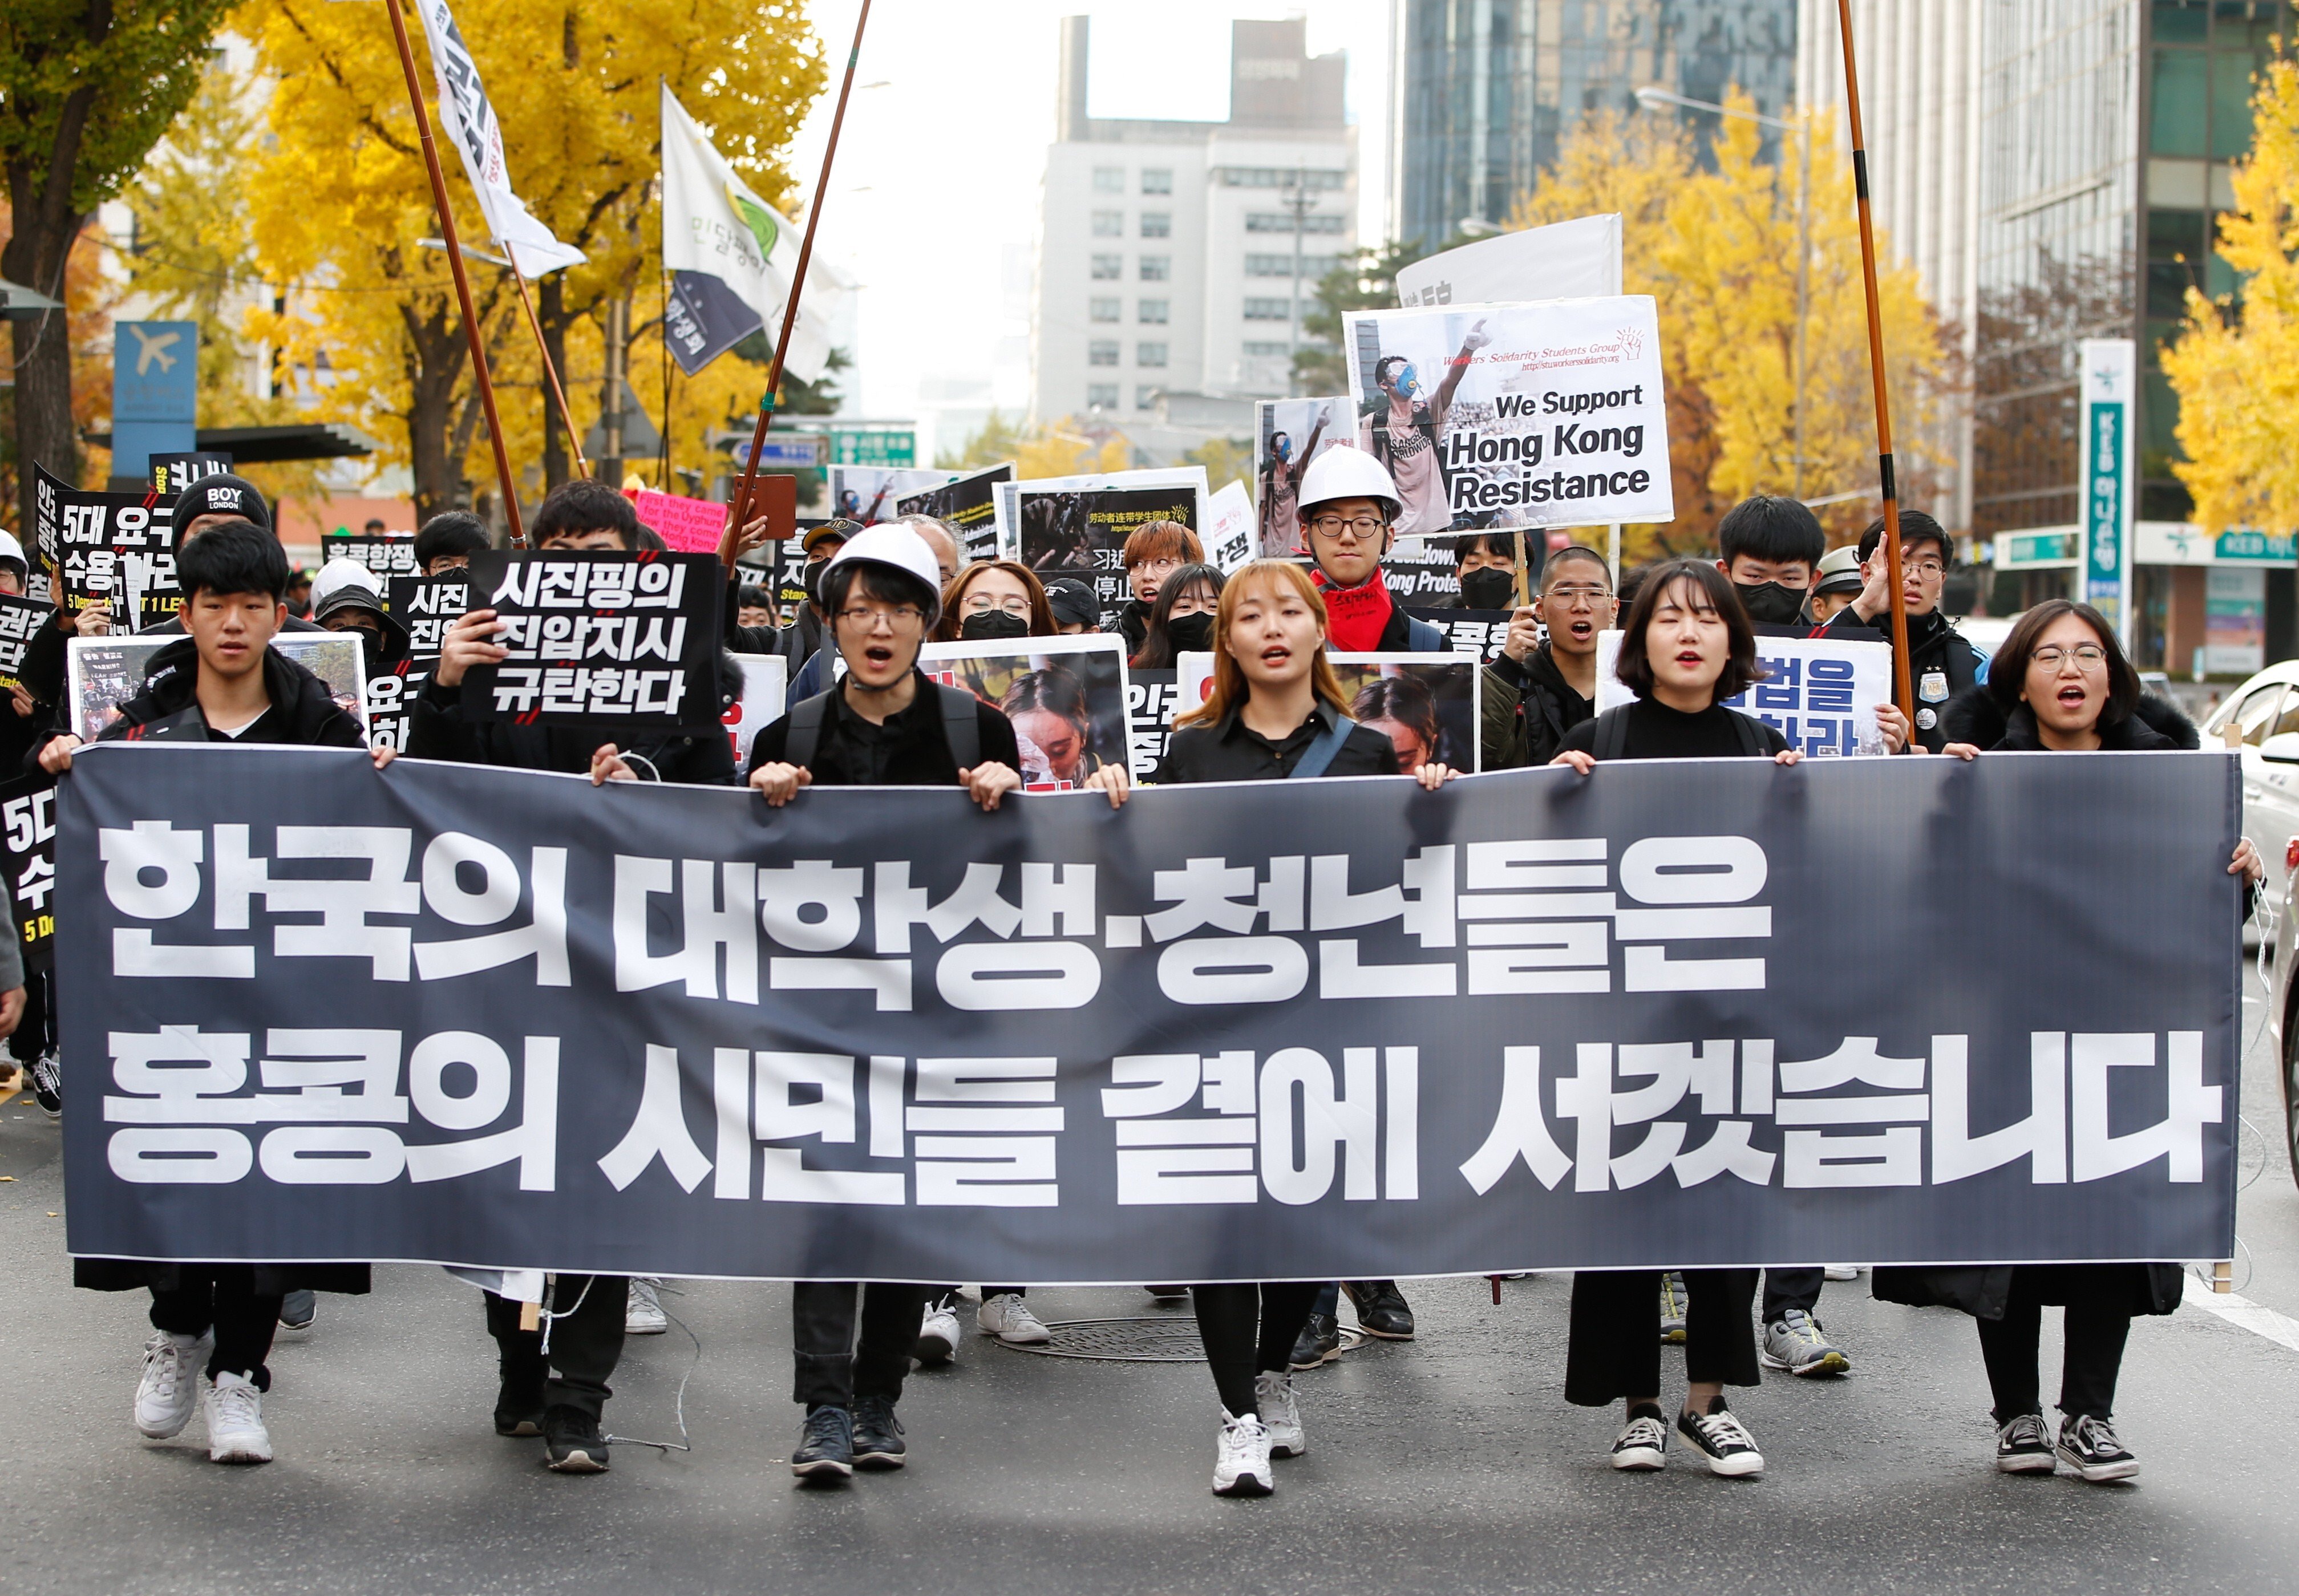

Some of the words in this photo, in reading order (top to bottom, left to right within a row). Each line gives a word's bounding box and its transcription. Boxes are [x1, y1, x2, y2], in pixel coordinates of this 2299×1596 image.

[1490, 350, 1539, 363] Solidarity
[1541, 346, 1586, 358] Students
[1589, 343, 1620, 355] Group
[1496, 395, 1536, 418] We
[1543, 384, 1643, 416] Support
[1451, 432, 1543, 467] Hong
[1554, 423, 1644, 457] Kong
[207, 487, 243, 502] BOY
[639, 493, 663, 507] First
[669, 497, 691, 513] they
[695, 504, 723, 517] came
[1454, 469, 1650, 511] Resistance
[62, 505, 107, 545] 5대
[644, 505, 659, 515] for
[663, 508, 681, 520] the
[682, 512, 722, 529] Uyghurs
[663, 521, 686, 534] they
[690, 526, 718, 539] come
[661, 530, 688, 545] Hong
[1092, 548, 1126, 570] 习近
[407, 584, 468, 615] 시진
[490, 561, 687, 609] 시진핑의
[780, 589, 808, 601] Stan
[68, 594, 74, 609] 5
[152, 597, 158, 611] 1
[494, 615, 687, 663] 진압지시
[492, 667, 686, 716] 규탄한다
[99, 820, 571, 987] 한국의
[104, 1025, 560, 1192] 홍콩의
[597, 1043, 1065, 1207] 시민들
[1100, 1046, 1419, 1205] 곁에
[1458, 1031, 2223, 1196] 서겠습니다
